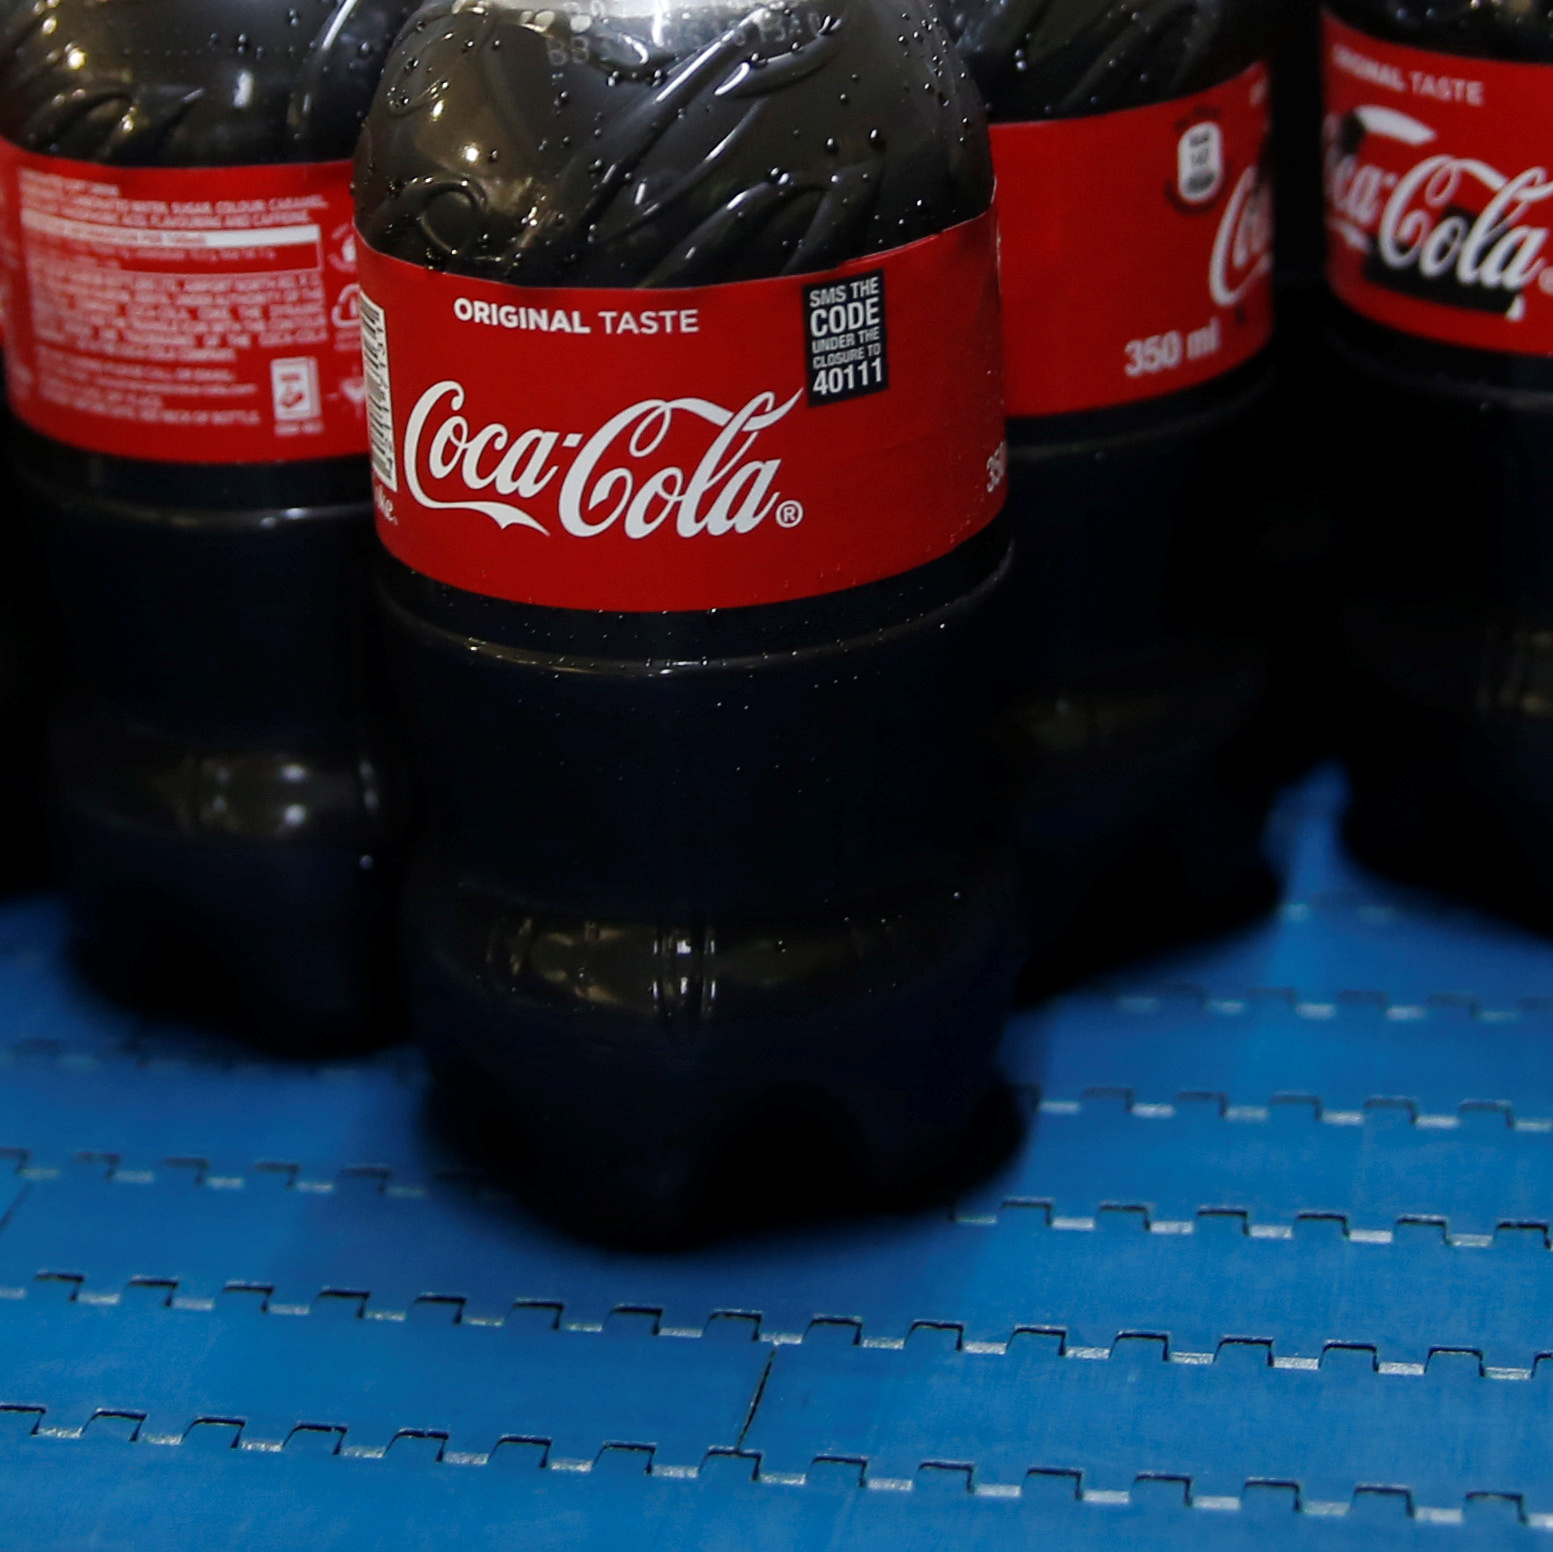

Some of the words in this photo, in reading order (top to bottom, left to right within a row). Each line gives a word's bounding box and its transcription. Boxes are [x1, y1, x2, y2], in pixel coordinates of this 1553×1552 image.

[1411, 70, 1484, 107] TASTE
[809, 285, 847, 308] SMS
[850, 276, 879, 299] THE
[453, 297, 591, 335] ORIGINAL
[598, 308, 699, 335] TASTE
[810, 296, 880, 338] CODE
[812, 333, 855, 354] UNDER
[857, 326, 880, 344] THE
[812, 347, 865, 369] CLOSURE
[867, 342, 881, 356] TO
[1124, 330, 1182, 378] 350
[1186, 316, 1220, 360] ml
[812, 357, 882, 395] 40111
